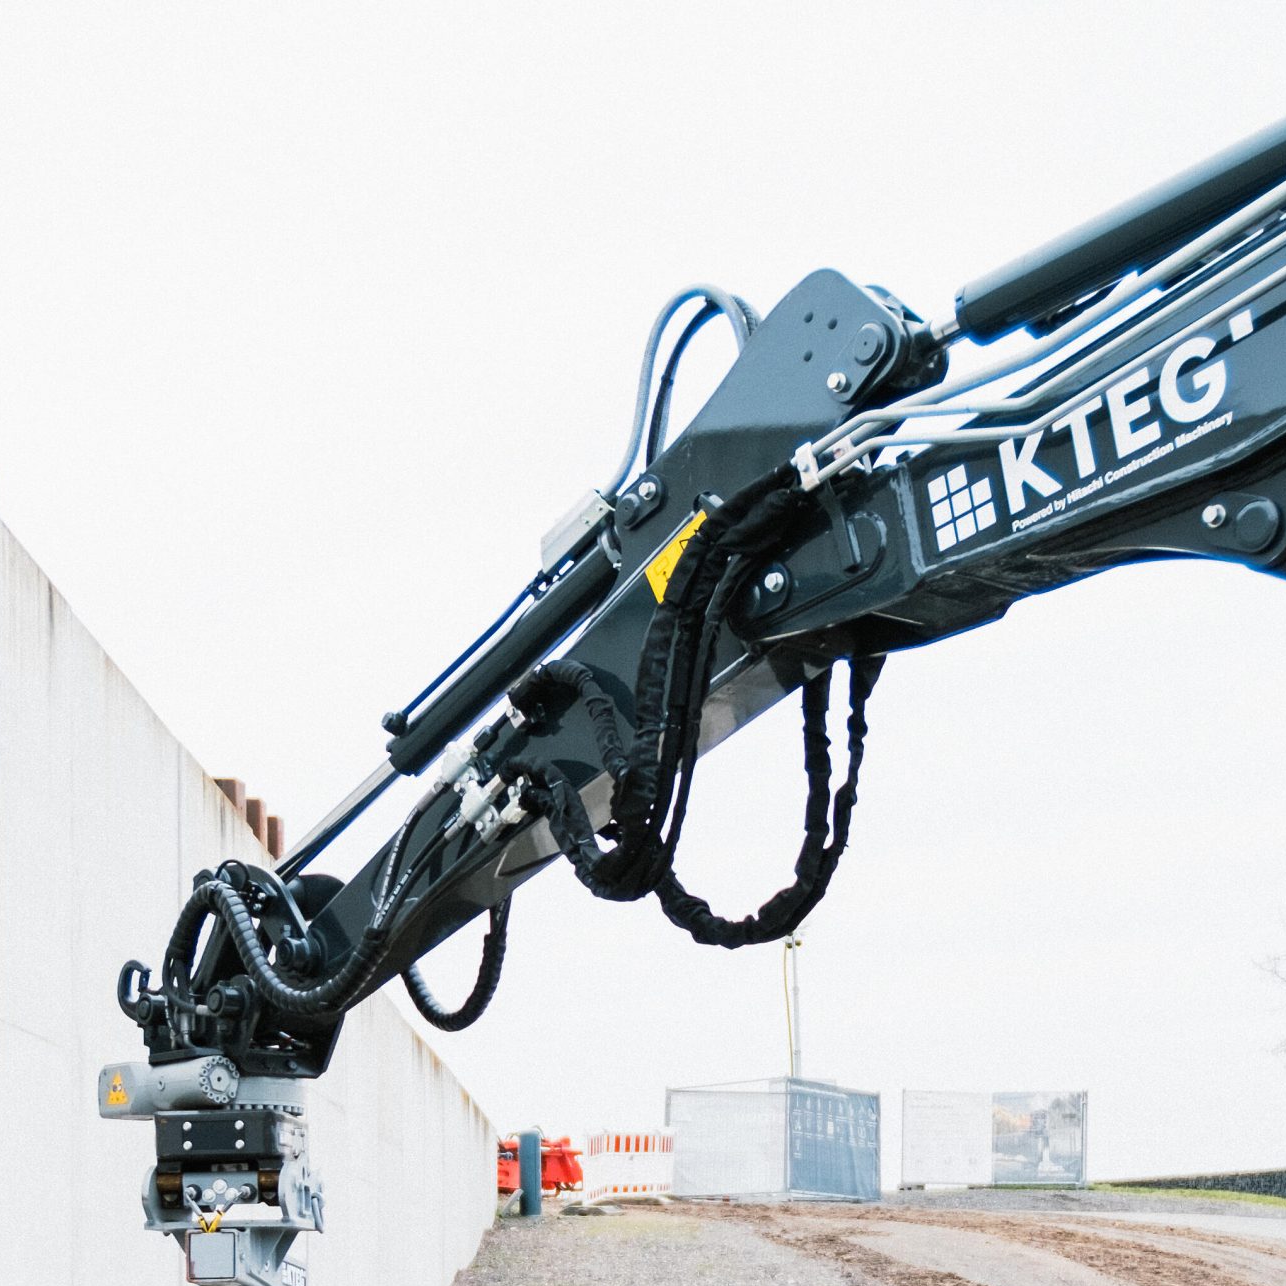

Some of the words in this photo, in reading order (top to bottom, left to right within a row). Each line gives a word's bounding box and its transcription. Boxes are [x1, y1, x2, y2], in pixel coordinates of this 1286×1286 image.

[998, 336, 1227, 515] KTEG
[1011, 502, 1053, 533] Powered
[1054, 498, 1066, 511] by
[1067, 476, 1104, 504] Hitachi
[1104, 442, 1174, 485] Construction
[1175, 411, 1233, 448] Machinery
